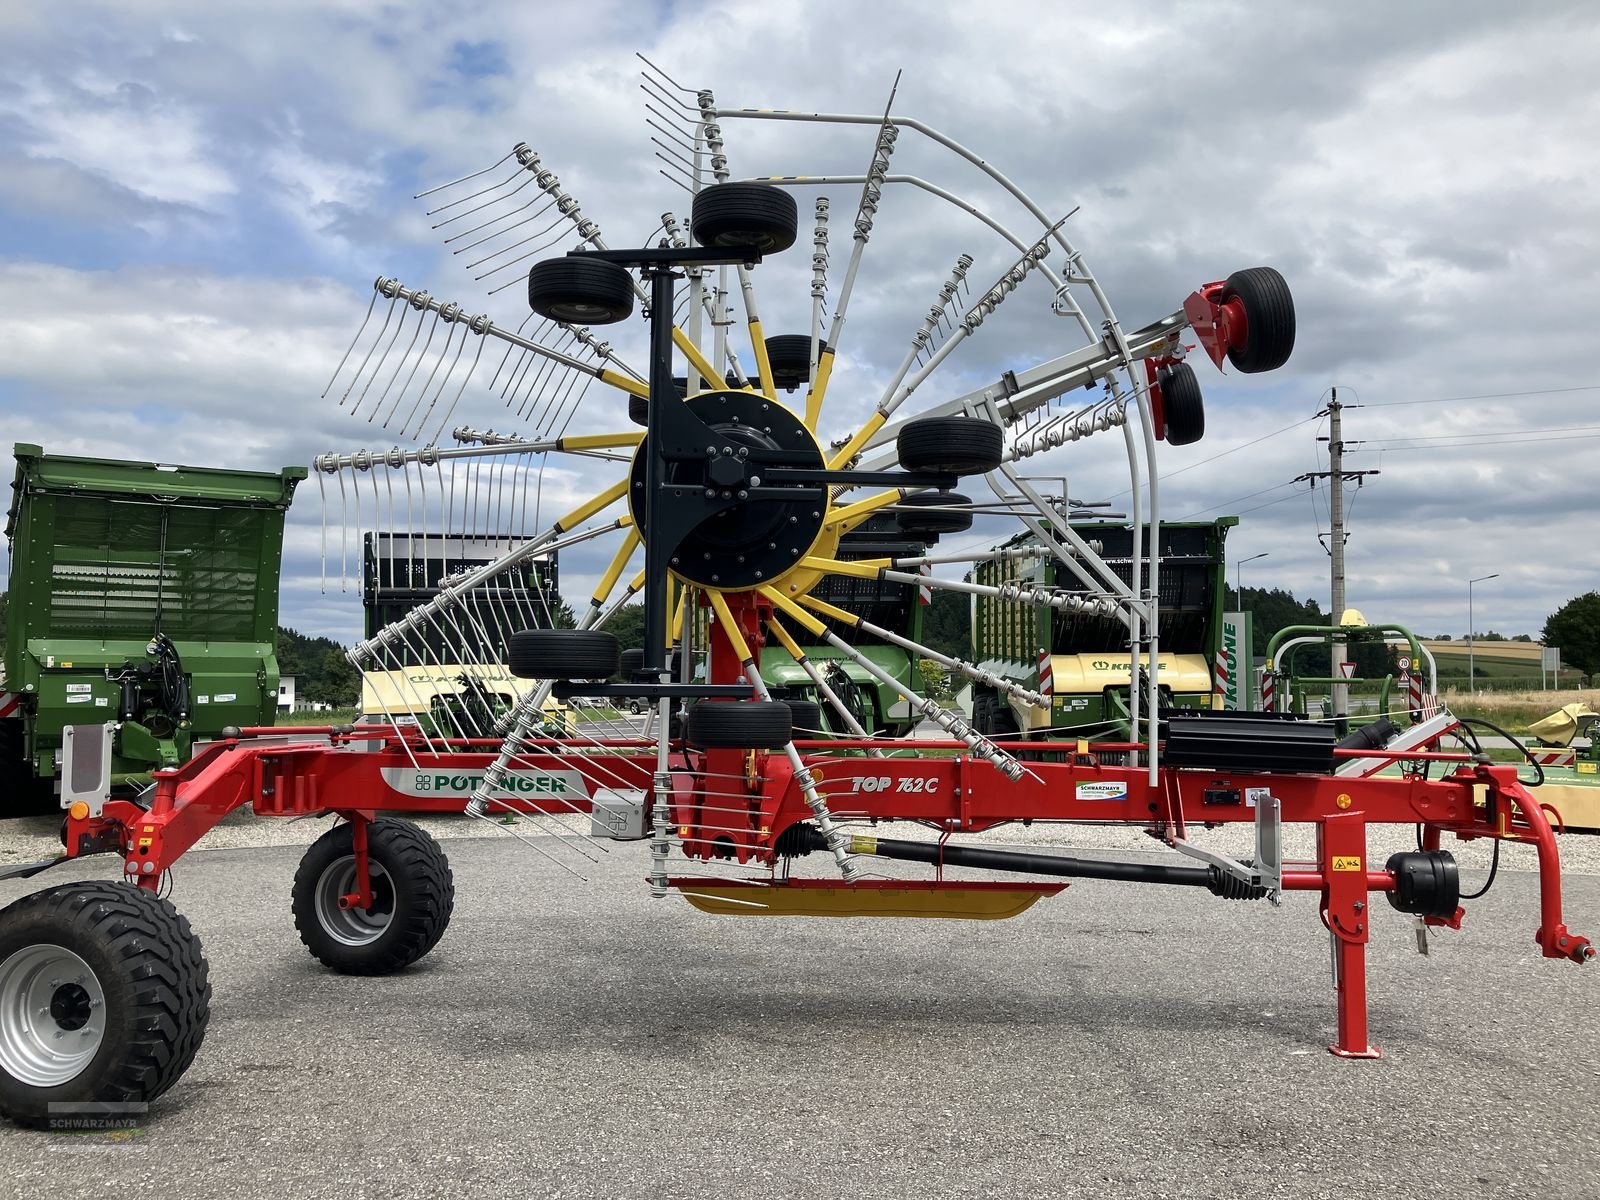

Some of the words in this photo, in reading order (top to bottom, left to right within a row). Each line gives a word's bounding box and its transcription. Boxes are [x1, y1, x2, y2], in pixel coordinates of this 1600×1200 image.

[1224, 622, 1237, 703] KRONE
[434, 775, 566, 792] PÖTNGER
[852, 776, 892, 792] TOP
